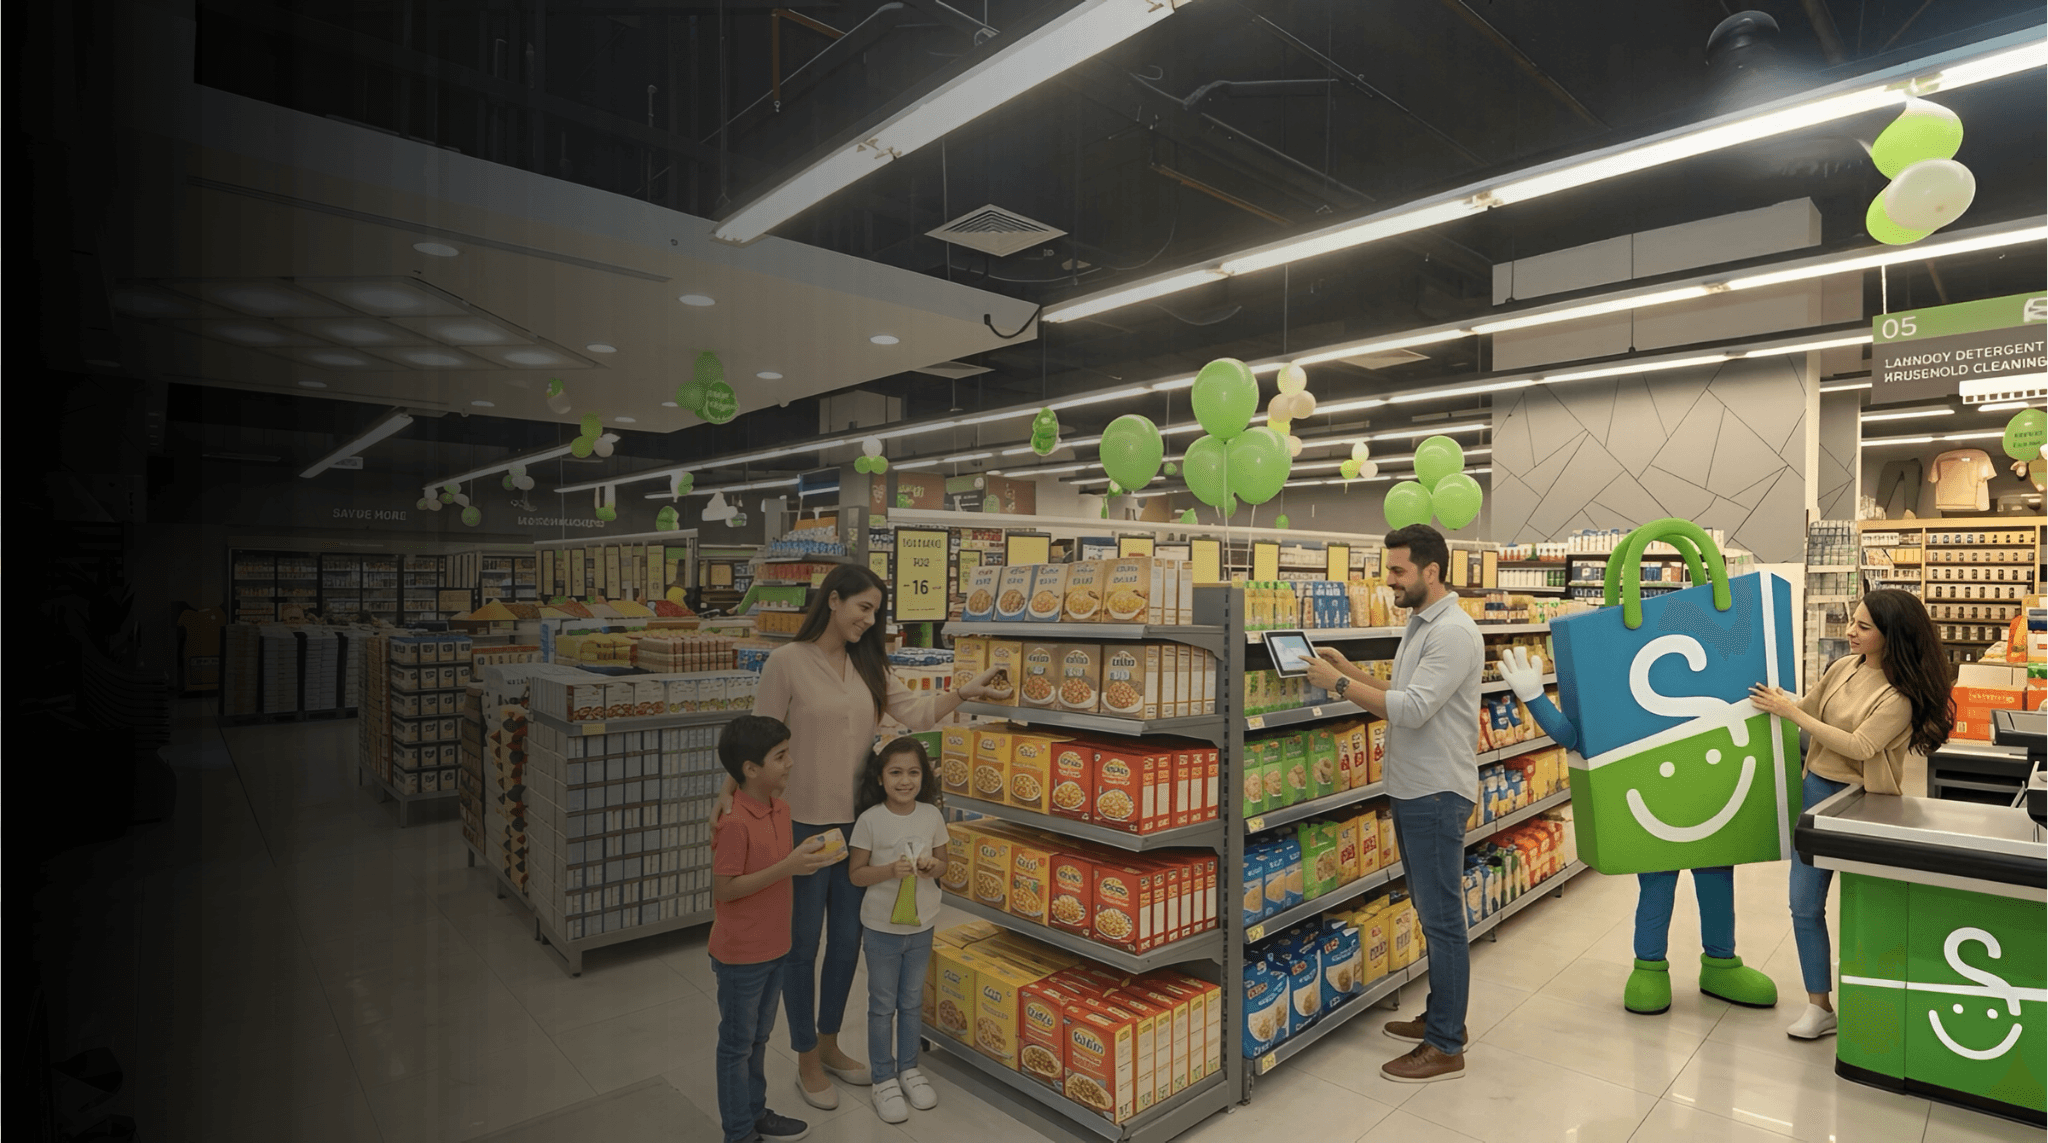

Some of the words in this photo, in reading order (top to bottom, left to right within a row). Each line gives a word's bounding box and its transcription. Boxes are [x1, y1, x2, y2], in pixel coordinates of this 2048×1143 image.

[1882, 316, 1917, 339] 05
[1955, 341, 2045, 361] DETERGENT
[1973, 356, 2047, 374] CLEANING
[912, 579, 929, 595] 16
